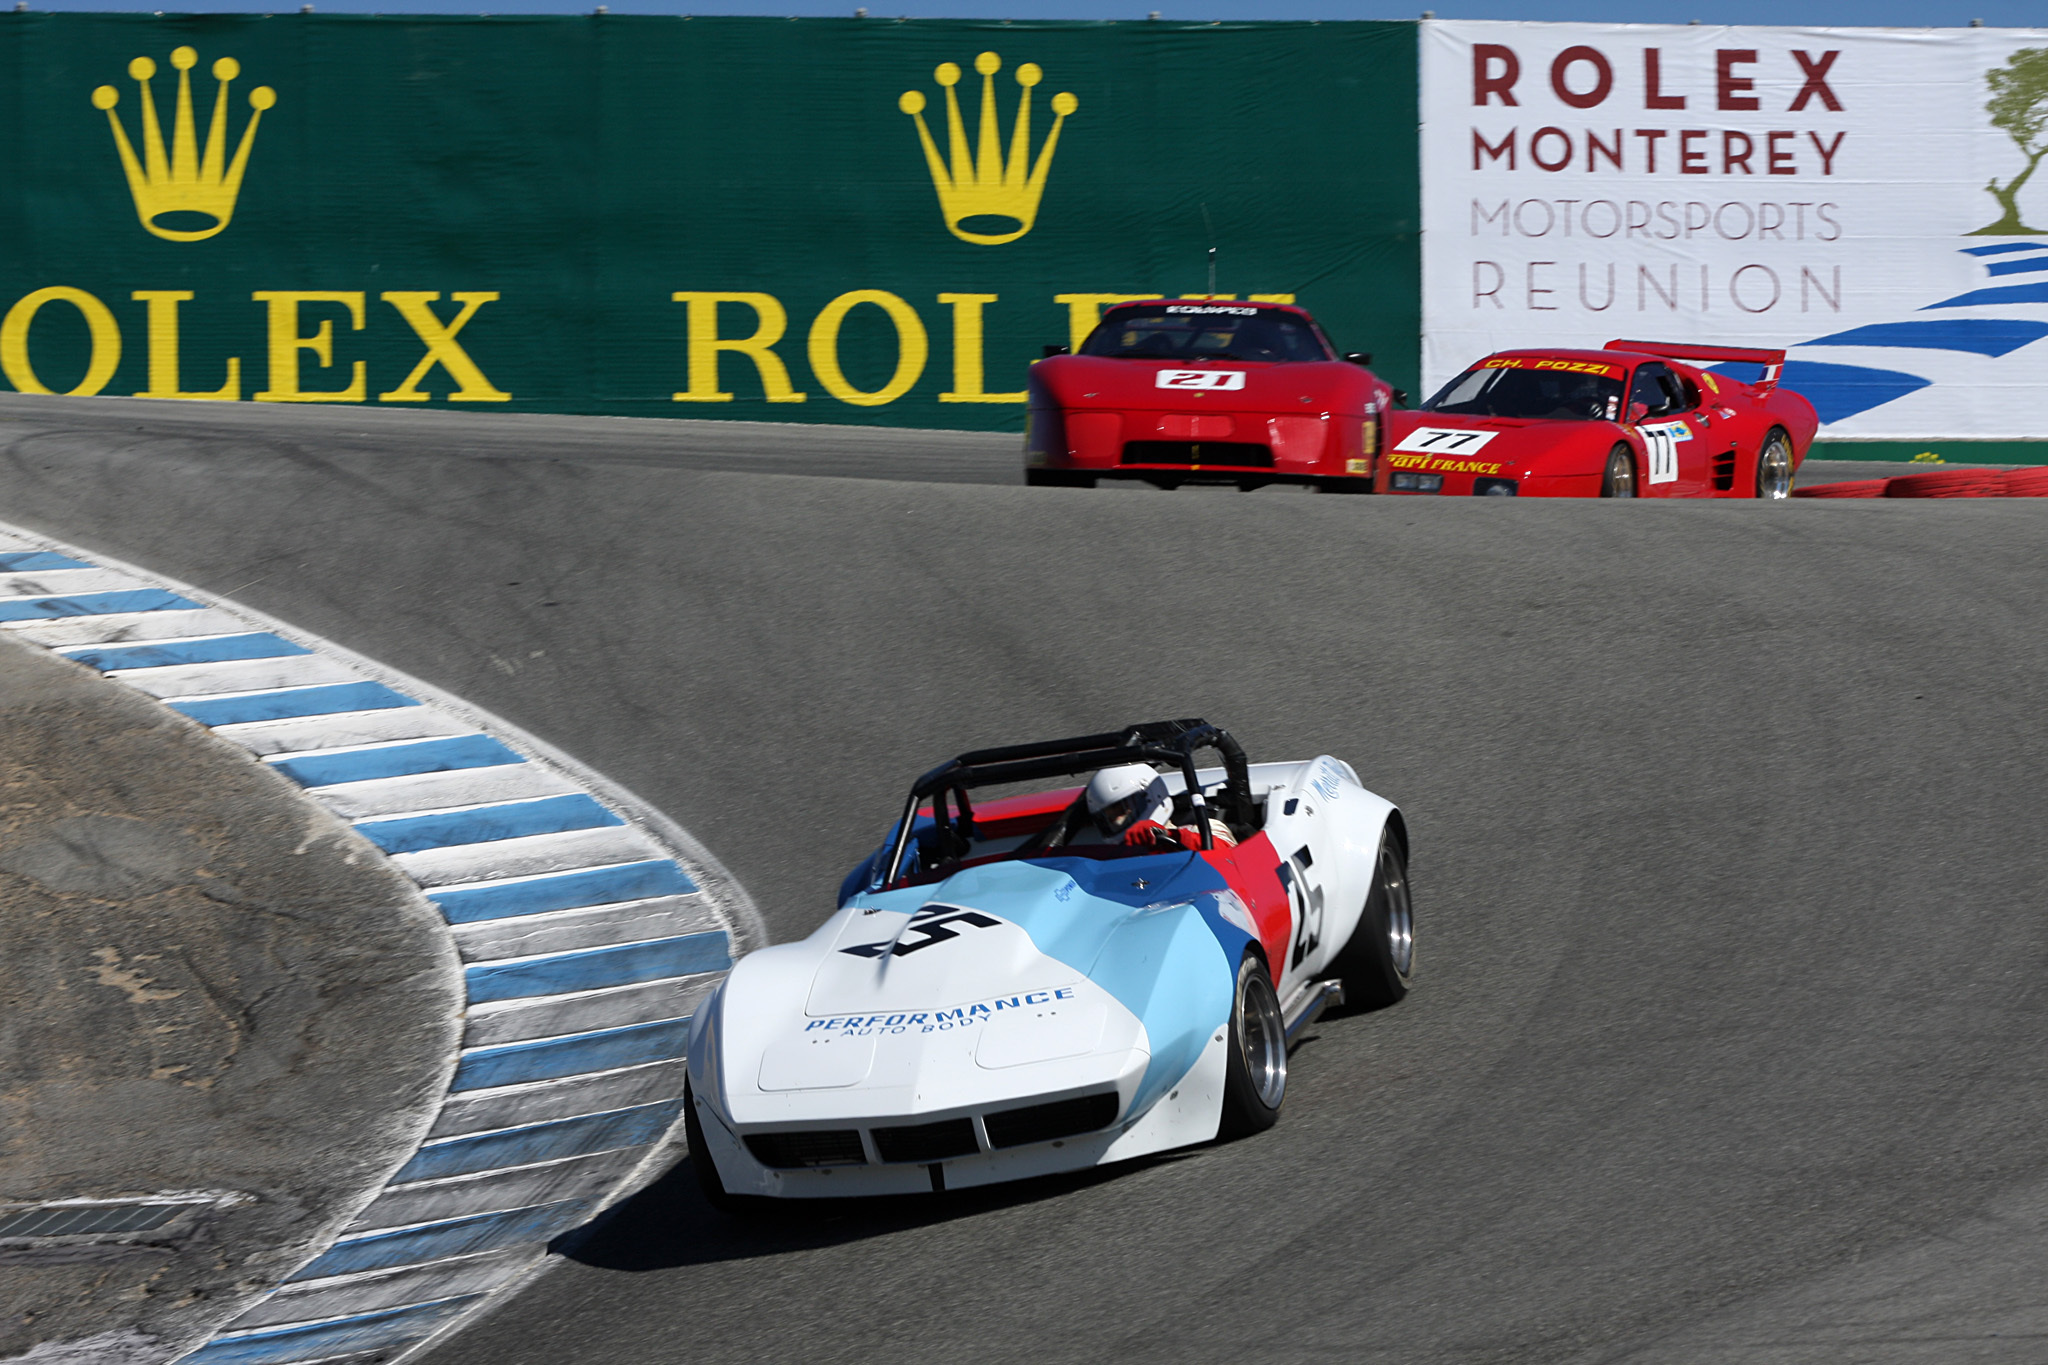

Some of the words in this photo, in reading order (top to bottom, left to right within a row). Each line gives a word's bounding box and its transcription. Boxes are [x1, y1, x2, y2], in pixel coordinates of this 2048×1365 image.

[1473, 44, 1846, 112] ROLEX
[1472, 126, 1848, 176] MONTEREY
[1471, 199, 1842, 242] MOTORSPORTS
[1472, 260, 1842, 314] REUNION
[671, 289, 1296, 406] ROL
[1484, 359, 1524, 369] CH.
[1534, 360, 1611, 375] POZZI
[1167, 372, 1234, 387] 21
[1418, 431, 1480, 450] 77
[1430, 458, 1502, 475] FRANCE
[804, 986, 1076, 1032] PERFORMANCE
[840, 1024, 908, 1037] AUTO
[920, 1011, 993, 1034] BODY
